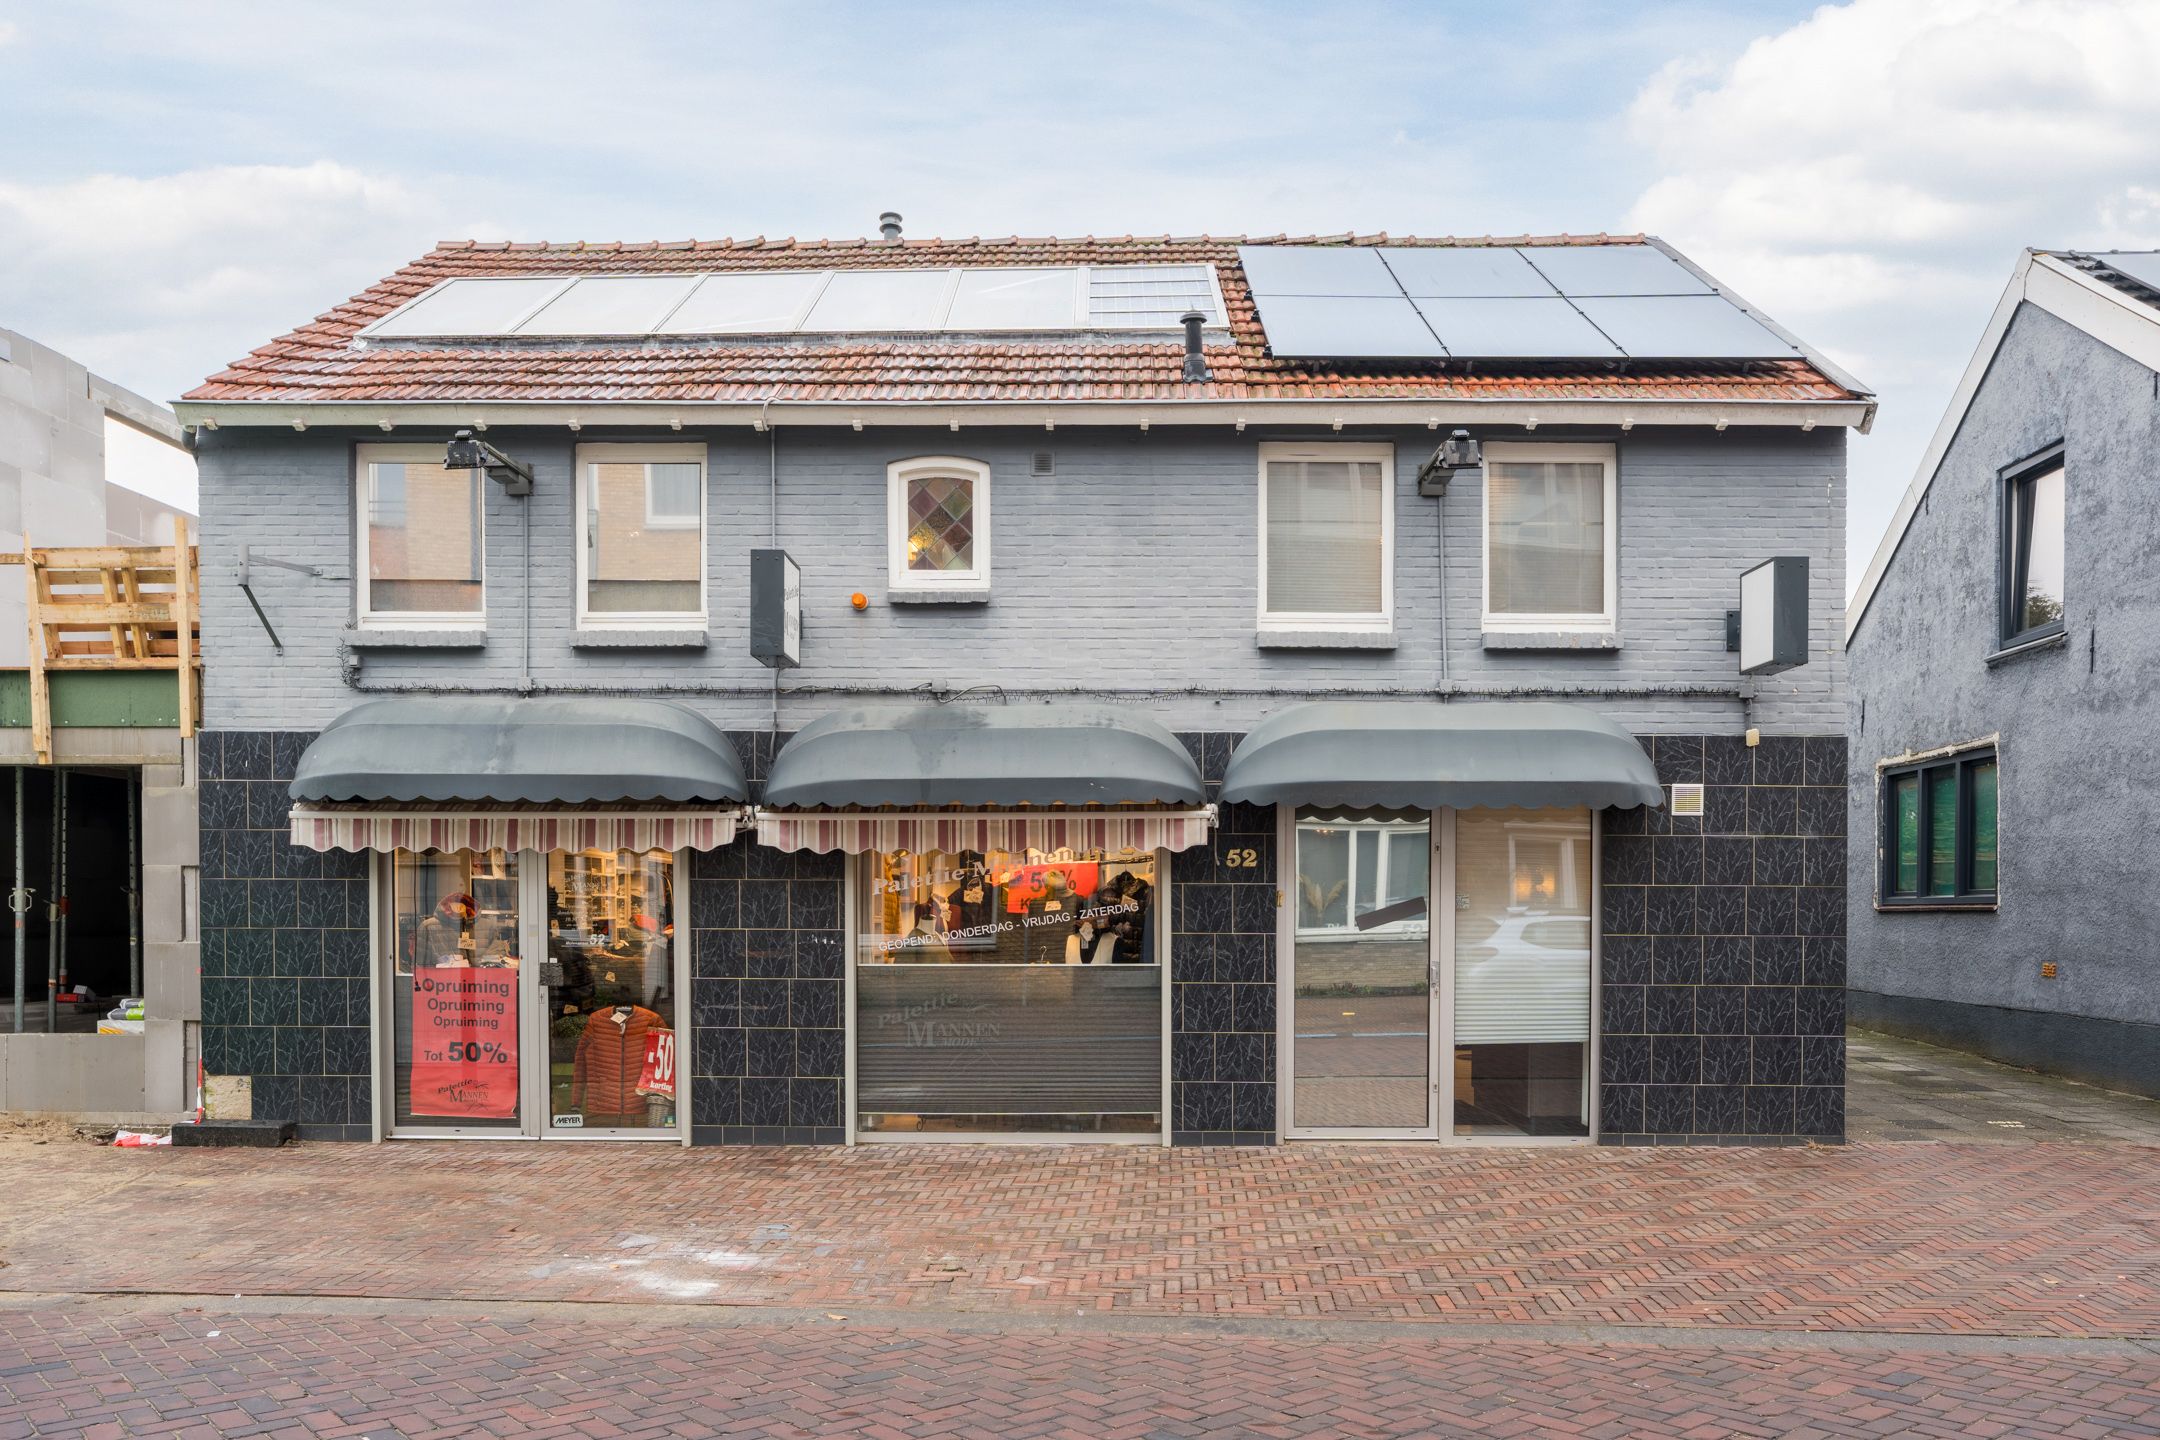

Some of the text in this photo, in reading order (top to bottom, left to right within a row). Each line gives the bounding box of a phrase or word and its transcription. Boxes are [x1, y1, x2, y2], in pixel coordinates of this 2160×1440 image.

[1226, 848, 1258, 868] 52
[872, 867, 965, 896] Palettie
[972, 850, 1073, 878] Mnen
[1030, 869, 1077, 892] 5%
[879, 933, 937, 951] GEOPEND:
[942, 921, 1014, 941] DONDERDAG
[1022, 912, 1071, 928] VRIJDAG
[1080, 902, 1140, 919] ZATERDAG
[590, 933, 605, 945] 52
[422, 978, 509, 997] Opruiming
[427, 998, 504, 1015] Opruiming
[433, 1015, 499, 1030] Opruiming
[904, 1021, 1000, 1047] MANNEN
[424, 1041, 508, 1063] Tot 50%
[649, 1080, 673, 1092] korting
[555, 1116, 581, 1124] MEYER
